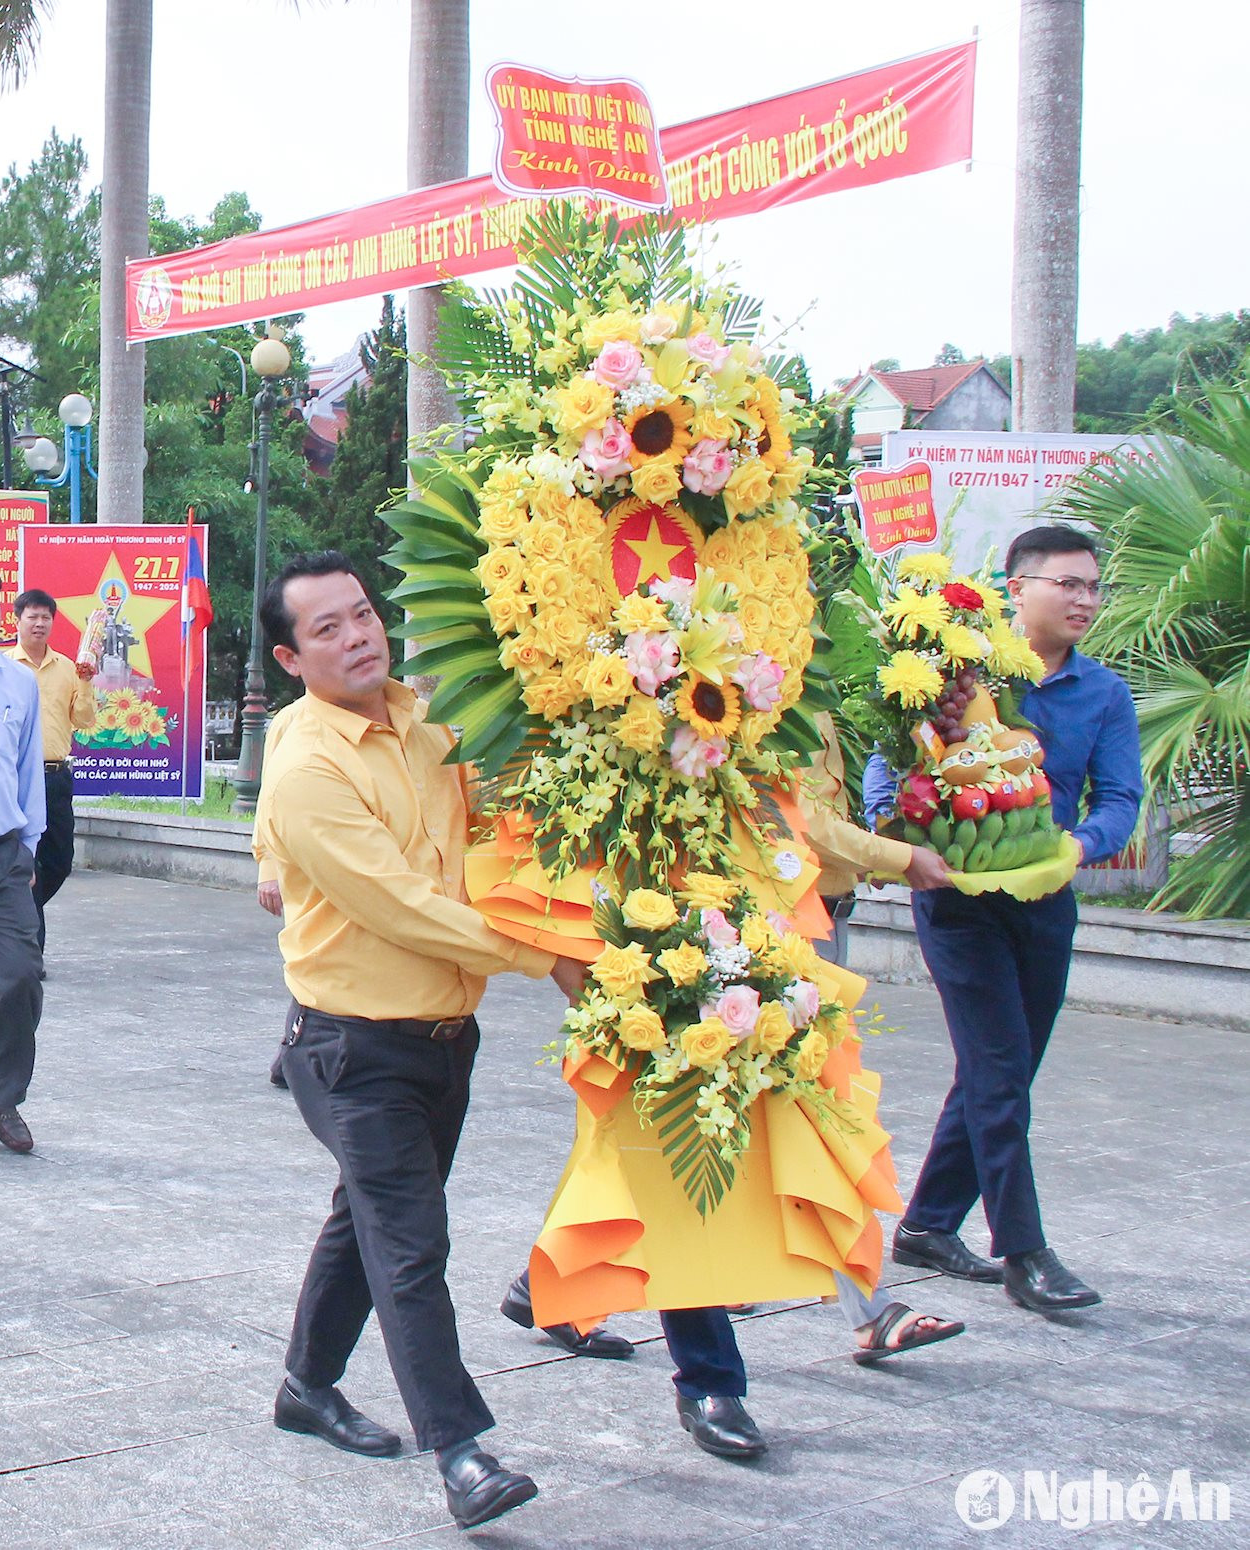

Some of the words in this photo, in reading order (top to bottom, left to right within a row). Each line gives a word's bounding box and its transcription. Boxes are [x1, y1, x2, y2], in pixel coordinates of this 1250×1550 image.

[519, 86, 550, 112] BAN
[552, 91, 592, 120] MTTQ
[625, 101, 654, 131] NAM
[523, 112, 566, 144] TỈNH
[570, 121, 619, 155] NGHỆ
[624, 131, 649, 155] AN
[507, 150, 583, 175] Kính
[589, 160, 661, 190] Dâng
[222, 267, 241, 307] GHI
[244, 251, 267, 302] NHỚ
[270, 250, 301, 297] CÔNG
[305, 247, 321, 290] ƠN
[324, 236, 349, 285] CÁC
[352, 235, 378, 280] ANH
[381, 222, 417, 273] HÙNG
[420, 211, 450, 271] LIỆT
[697, 142, 723, 202] CÓ
[727, 133, 781, 196] CÔNG
[783, 114, 817, 181] VỚI
[821, 98, 848, 171] TỔ
[852, 87, 908, 168] QUỐC
[926, 447, 957, 467] NIỆM
[959, 448, 974, 463] 77
[976, 447, 1004, 463] NĂM
[1007, 446, 1038, 464] NGÀY
[1041, 449, 1086, 465] THƯƠNG
[949, 472, 1029, 488] (27/7/1947
[10, 505, 35, 522] NGƯỜI
[916, 502, 928, 517] AN
[146, 536, 162, 544] BINH
[134, 556, 180, 579] 27.7
[134, 583, 152, 591] 1947
[159, 583, 179, 591] 2024
[132, 759, 148, 767] GHI
[150, 757, 169, 767] NHỚ
[88, 769, 108, 779] CÁC
[109, 771, 127, 780] ANH
[129, 770, 153, 780] HÙNG
[154, 770, 169, 782] LIỆT
